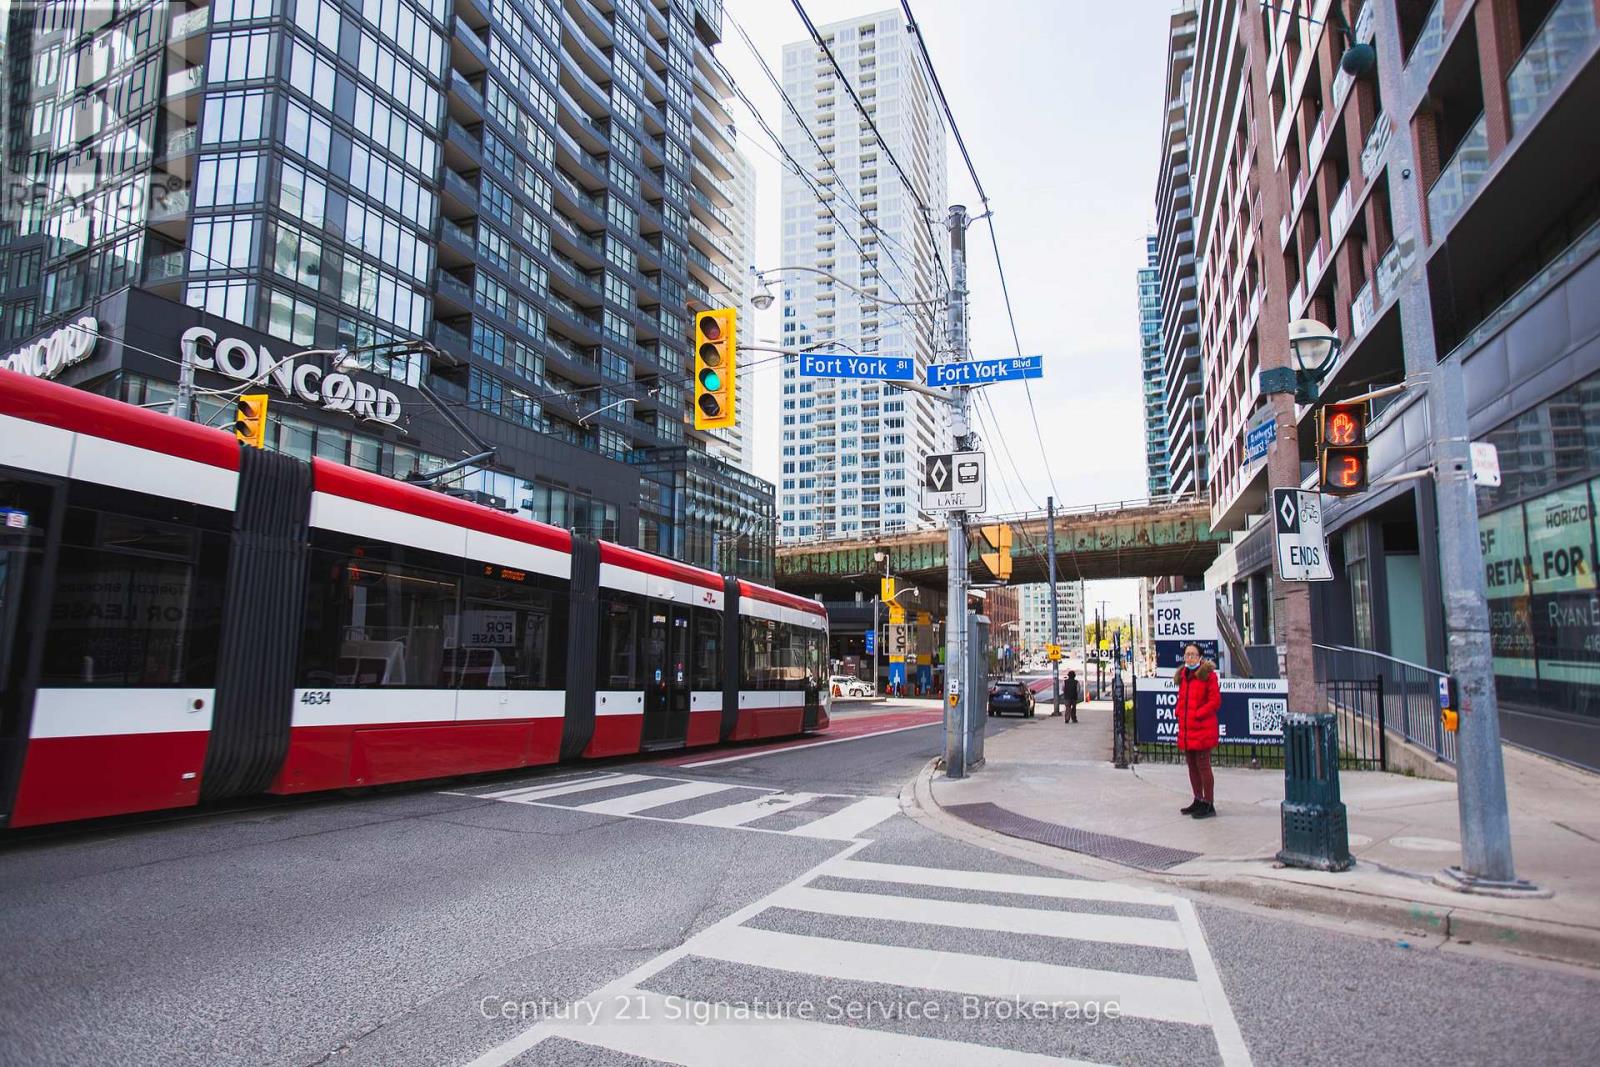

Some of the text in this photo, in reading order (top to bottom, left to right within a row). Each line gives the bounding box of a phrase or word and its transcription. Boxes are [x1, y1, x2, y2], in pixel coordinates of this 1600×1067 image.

[805, 357, 842, 374] Fort
[848, 358, 888, 375] York
[936, 359, 1031, 382] Fort York Blvd
[1342, 457, 1359, 486] 2
[1290, 545, 1320, 566] ENDS
[1543, 546, 1586, 579] FOR
[1157, 608, 1181, 621] FOR
[1157, 622, 1195, 635] LEASE
[1239, 680, 1256, 690] YORK
[1258, 680, 1277, 690] BLVD
[301, 691, 331, 705] 4634
